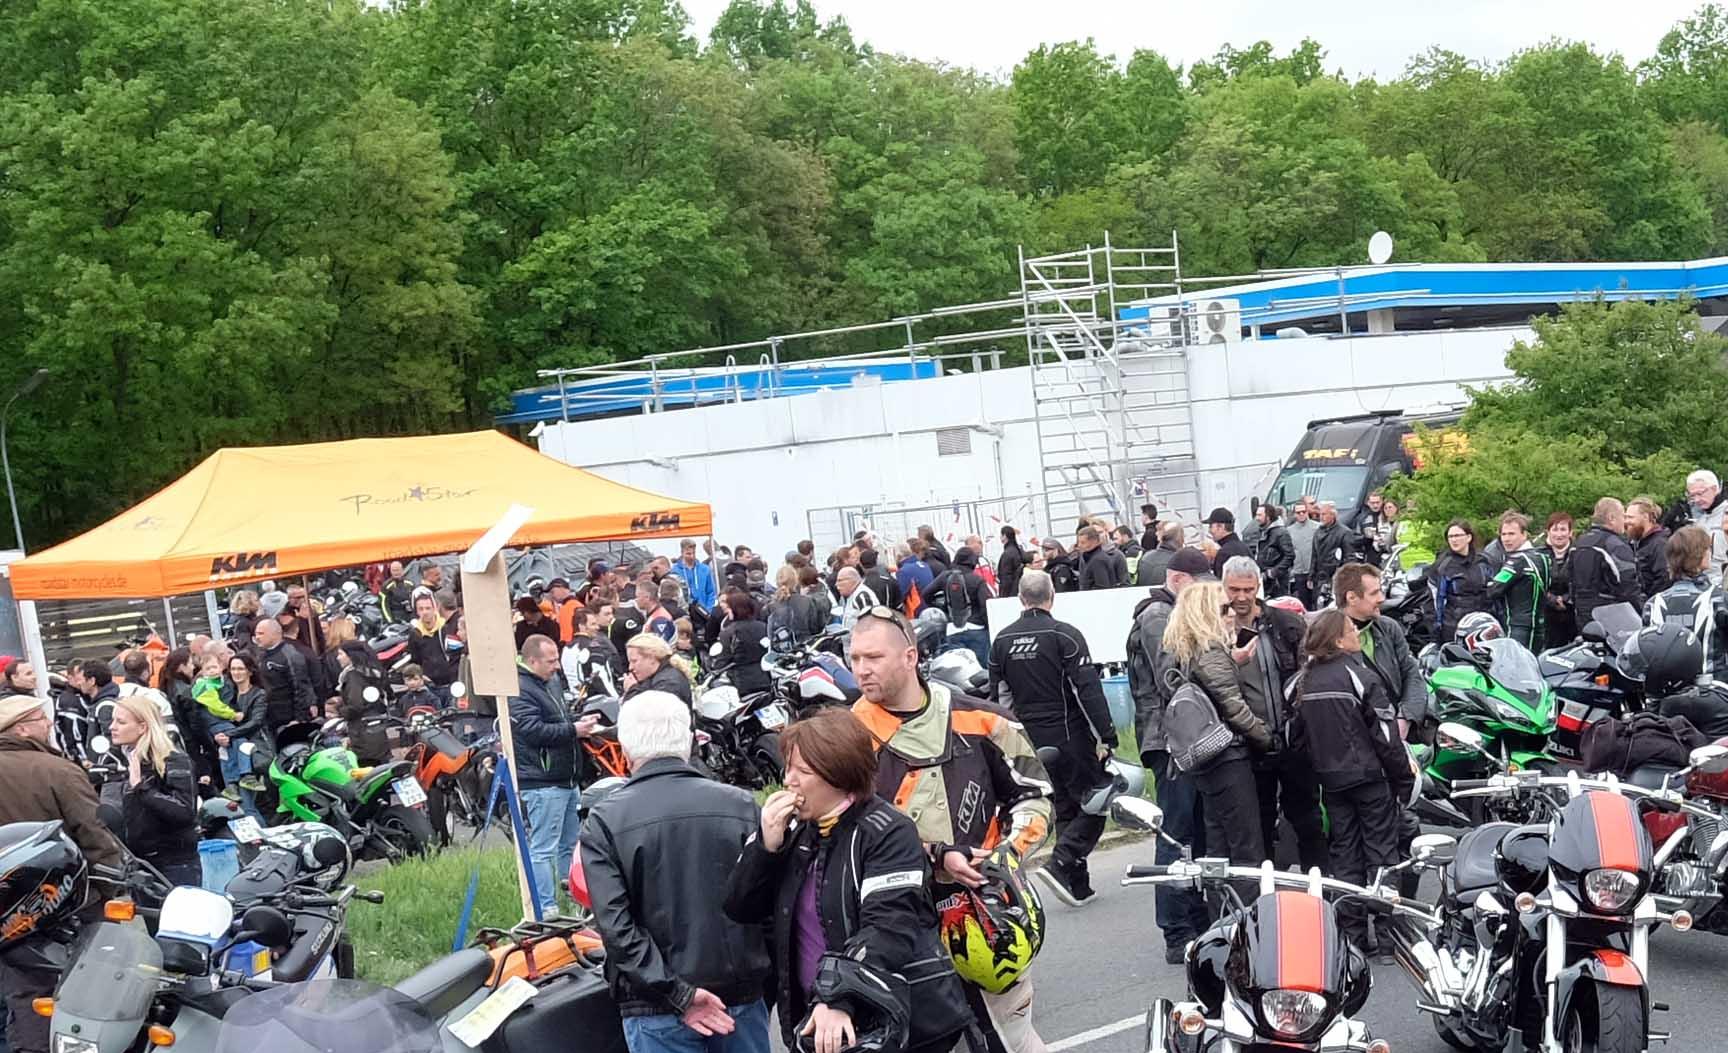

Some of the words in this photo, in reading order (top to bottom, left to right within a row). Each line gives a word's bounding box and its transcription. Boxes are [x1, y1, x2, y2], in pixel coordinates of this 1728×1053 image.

[631, 511, 680, 531] KTM
[210, 551, 277, 576] KTM
[957, 780, 981, 834] KTM
[310, 922, 334, 956] SUZUKI
